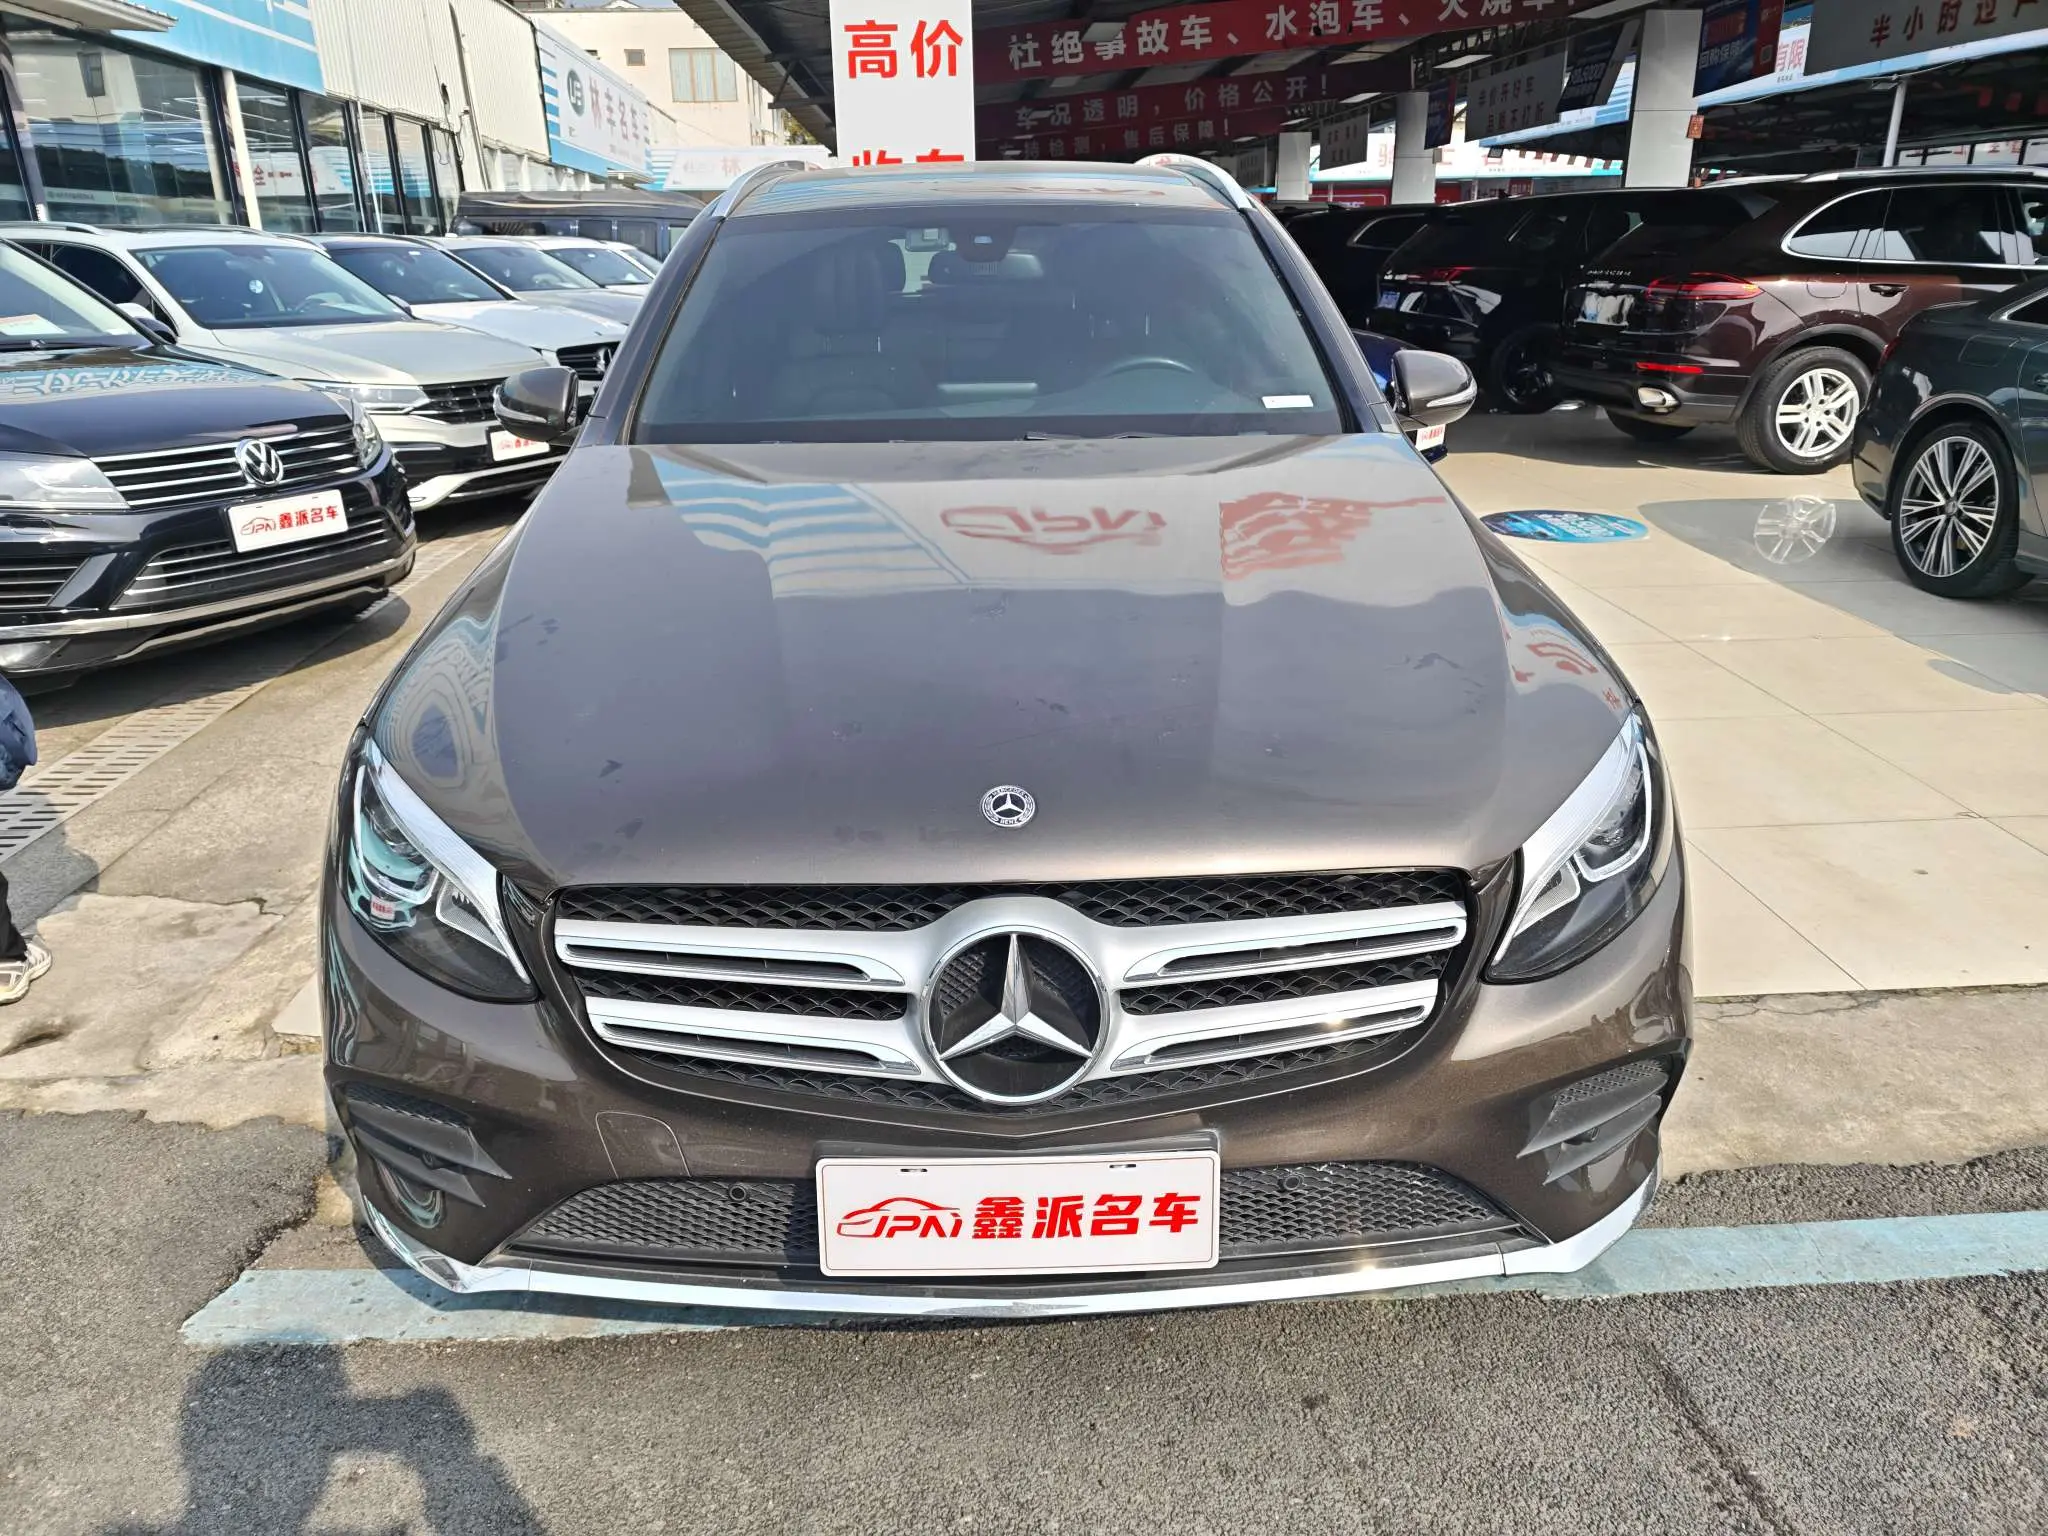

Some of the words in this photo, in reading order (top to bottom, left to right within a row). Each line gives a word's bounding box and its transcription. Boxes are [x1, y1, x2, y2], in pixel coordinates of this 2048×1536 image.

[844, 19, 964, 79] 高价
[279, 505, 339, 530] 鑫派名车
[971, 1192, 1202, 1240] 鑫派名车
